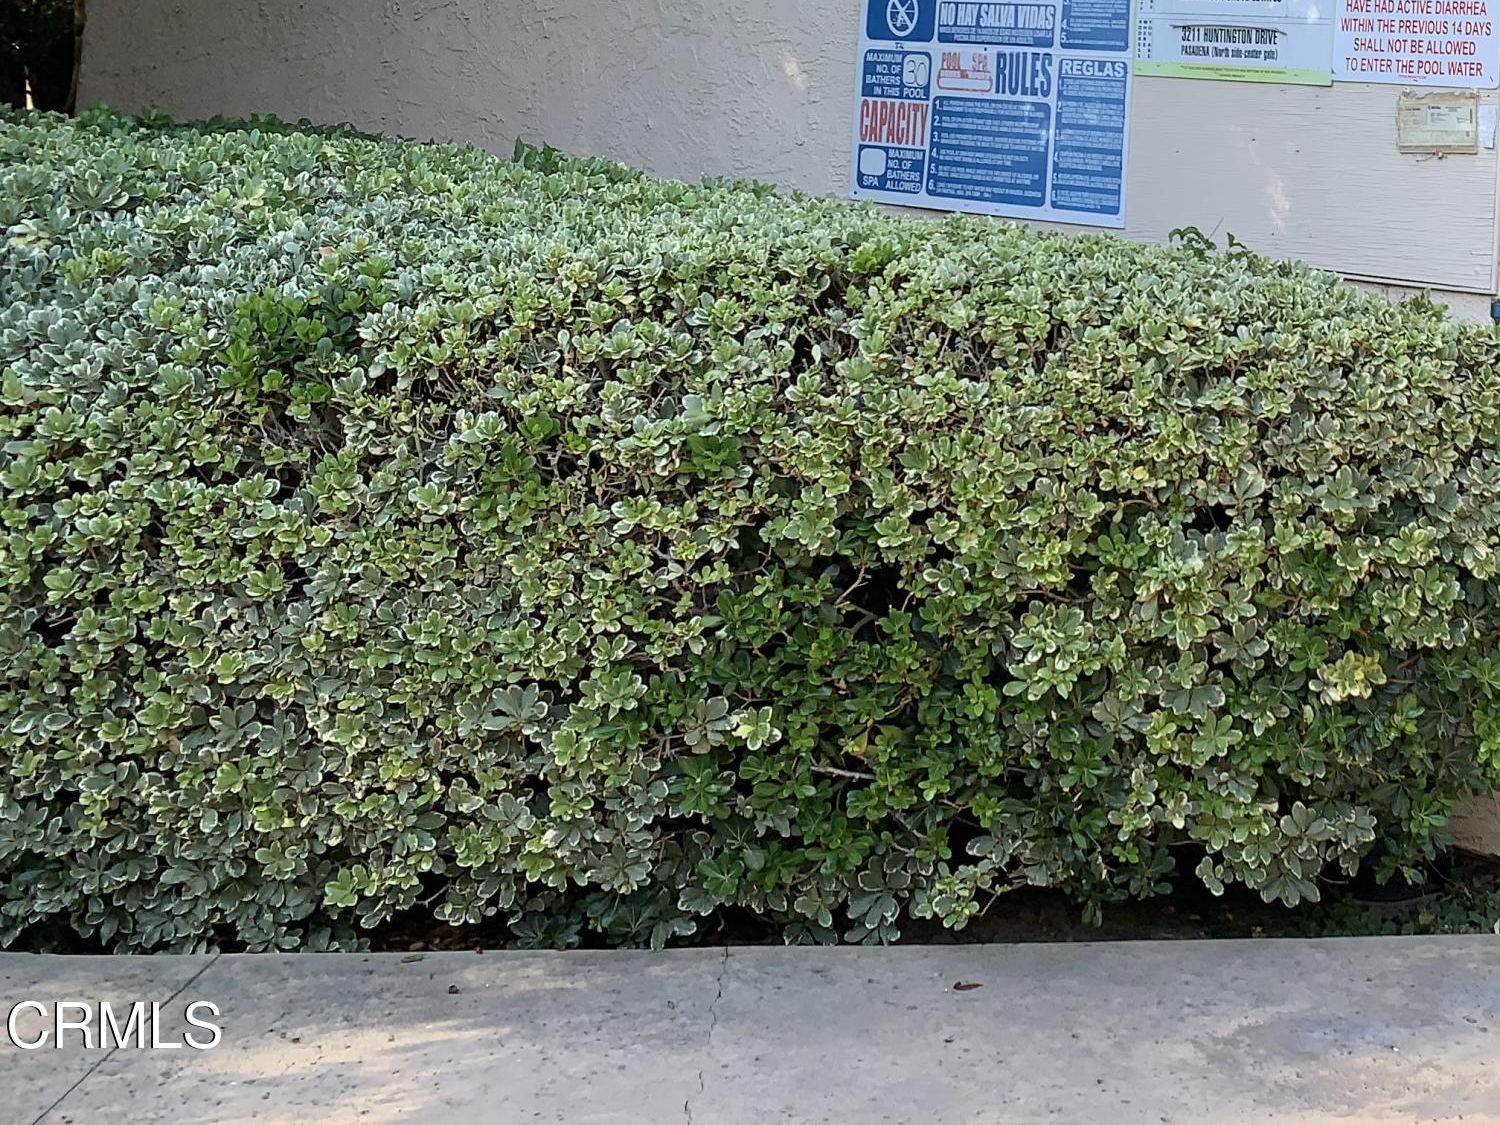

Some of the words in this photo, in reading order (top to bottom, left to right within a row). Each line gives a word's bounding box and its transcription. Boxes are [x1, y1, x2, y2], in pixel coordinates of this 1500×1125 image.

[1346, 0, 1371, 13] HAVE
[1374, 0, 1394, 13] HAD
[1397, 0, 1432, 14] ACTIVE
[1435, 1, 1487, 15] DIARRHEA
[940, 3, 956, 25] NO
[957, 4, 980, 26] HAY
[979, 5, 1015, 28] SALVA
[1017, 6, 1055, 30] VIDAS
[1341, 18, 1374, 32] WITHIN
[1377, 19, 1395, 33] THE
[1398, 20, 1448, 34] PREVIOUS
[1452, 21, 1462, 35] 14
[1465, 22, 1492, 36] DAYS
[1181, 26, 1201, 42] 3211
[1203, 28, 1252, 45] HUNTINGTON
[1255, 29, 1278, 45] DRIVE
[1181, 45, 1209, 57] PASADENA
[1211, 46, 1230, 59] (North
[1231, 46, 1262, 59] side-center
[1354, 38, 1384, 52] SHALL
[1387, 39, 1408, 53] NOT
[1410, 40, 1423, 54] BE
[1426, 40, 1476, 55] ALLOWED
[866, 53, 902, 62] MAXIMUM
[942, 52, 961, 69] POOL
[876, 64, 889, 73] NO.
[891, 65, 901, 74] OF
[905, 60, 927, 86] 30
[995, 51, 1052, 97] RULES
[1061, 60, 1125, 77] REGLAS
[1346, 58, 1357, 71] TO
[1361, 58, 1392, 73] ENTER
[1396, 59, 1414, 74] THE
[1417, 60, 1444, 75] POOL
[1448, 61, 1483, 76] WATER
[865, 75, 900, 85] BATHERS
[874, 87, 882, 95] IN
[883, 87, 899, 96] THIS
[903, 87, 927, 99] POOL
[860, 99, 929, 146] CAPACITY
[888, 149, 923, 160] MAXIMUM
[888, 159, 900, 168] NO.
[902, 160, 912, 170] OF
[863, 176, 878, 186] SPA
[887, 170, 920, 181] BATHERS
[885, 179, 921, 192] ALLOWED
